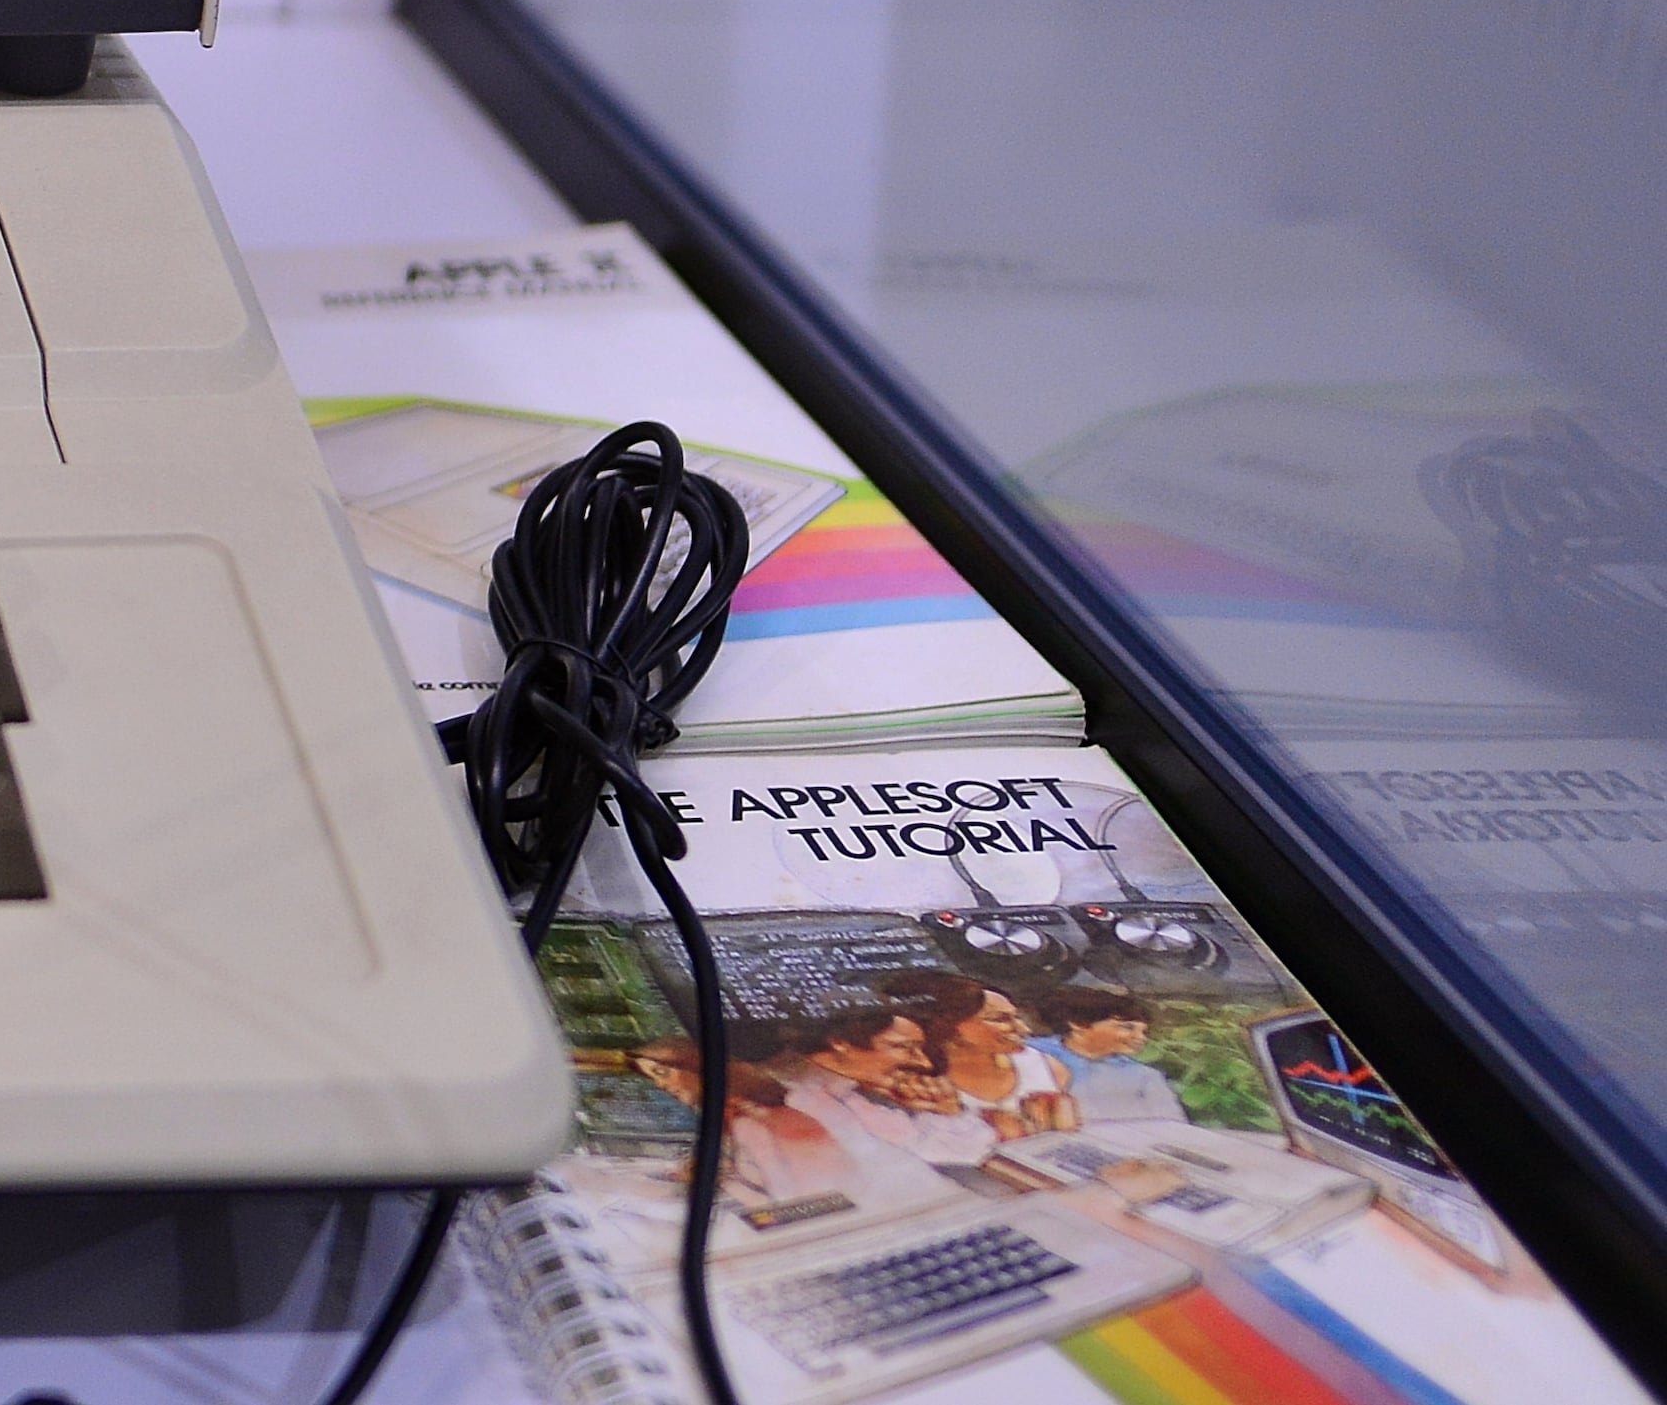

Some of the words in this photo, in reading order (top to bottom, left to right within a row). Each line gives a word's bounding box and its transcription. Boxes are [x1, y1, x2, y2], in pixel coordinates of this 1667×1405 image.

[596, 790, 705, 828] TE
[731, 777, 1074, 822] APPLESOFT
[788, 818, 1118, 862] TUTORIAL
